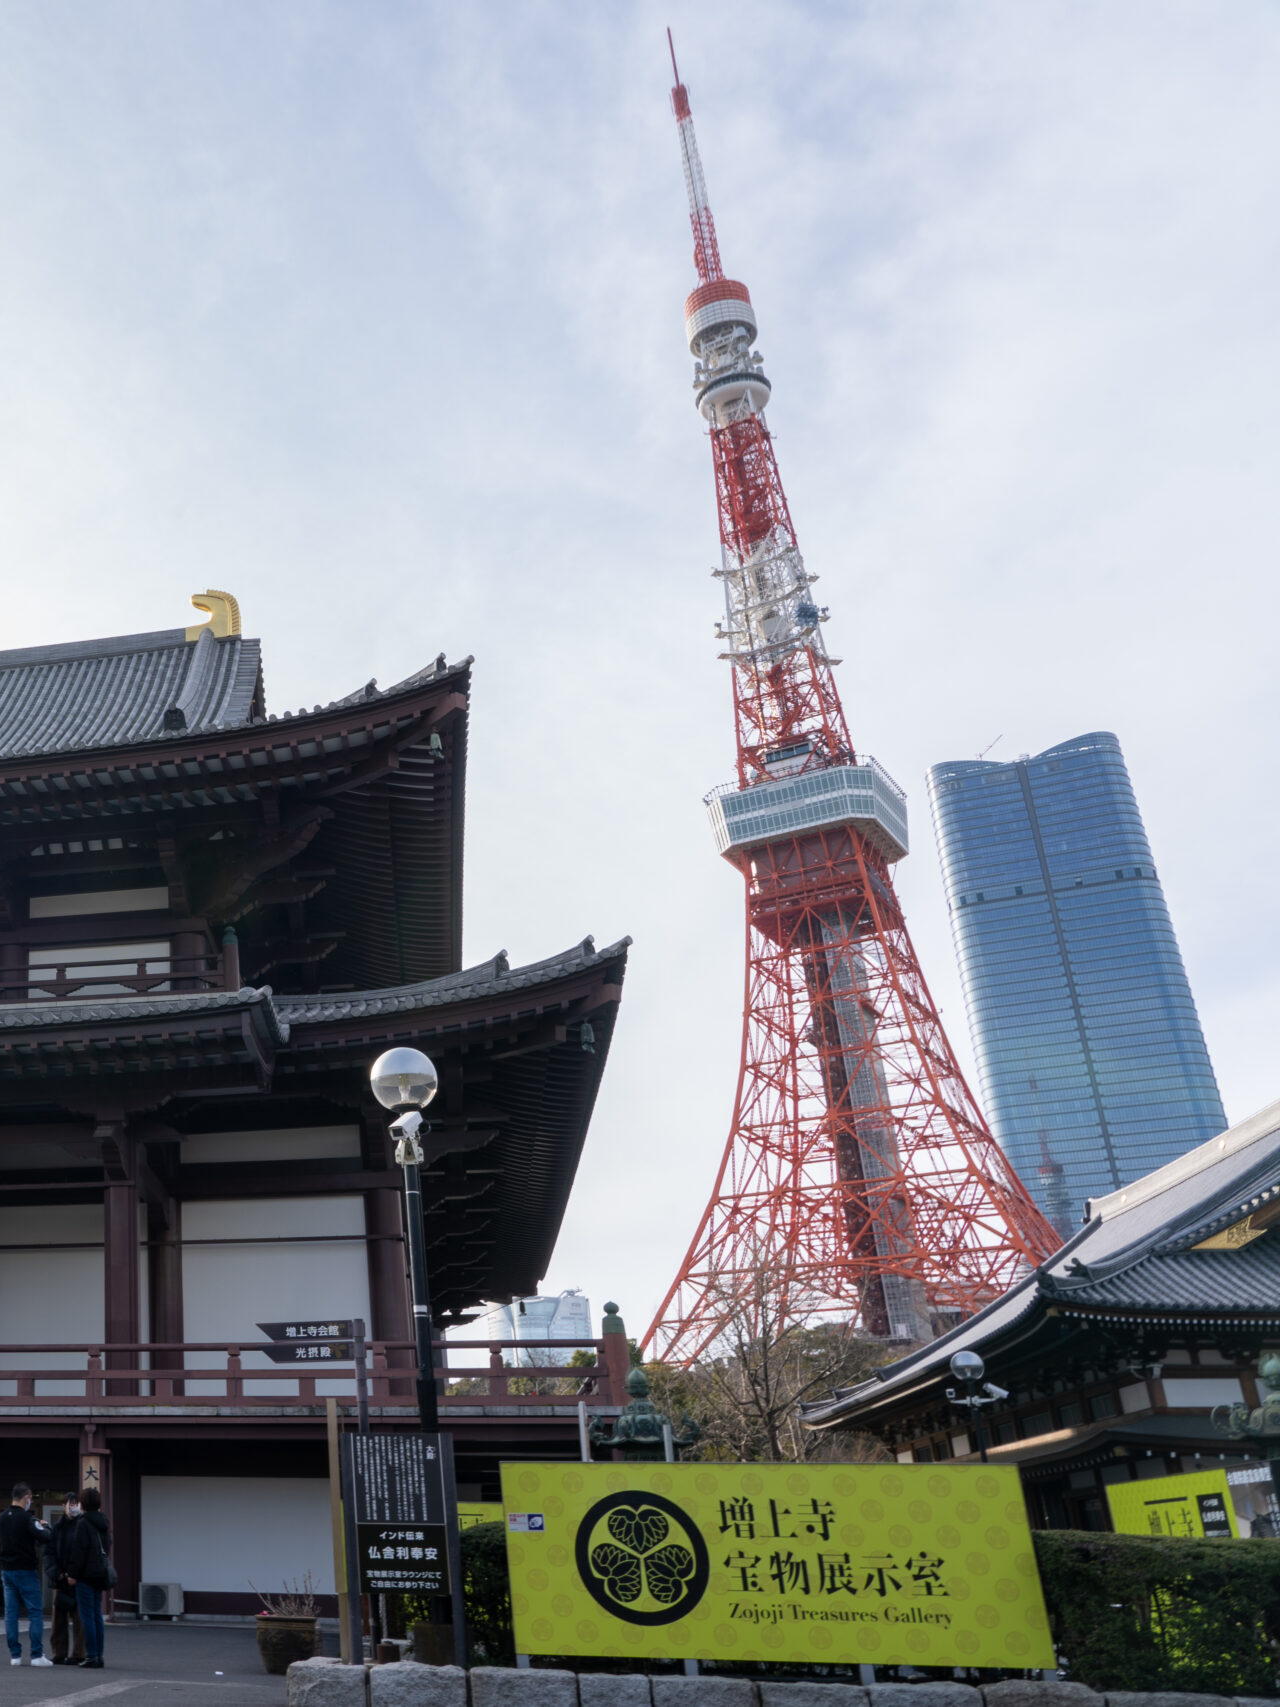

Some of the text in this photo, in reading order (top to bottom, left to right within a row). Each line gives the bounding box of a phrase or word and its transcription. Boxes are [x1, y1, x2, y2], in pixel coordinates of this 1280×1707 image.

[286, 1325, 339, 1337] 増上寺会館
[296, 1346, 331, 1358] 光摂殿
[717, 1497, 835, 1541] 増上寺
[379, 1531, 424, 1540] インド伝来
[723, 1551, 950, 1597] 宝物展示室
[370, 1580, 439, 1589] ご自由にお参り下さい
[729, 1602, 952, 1630] Zojoji Treasures Gallery
